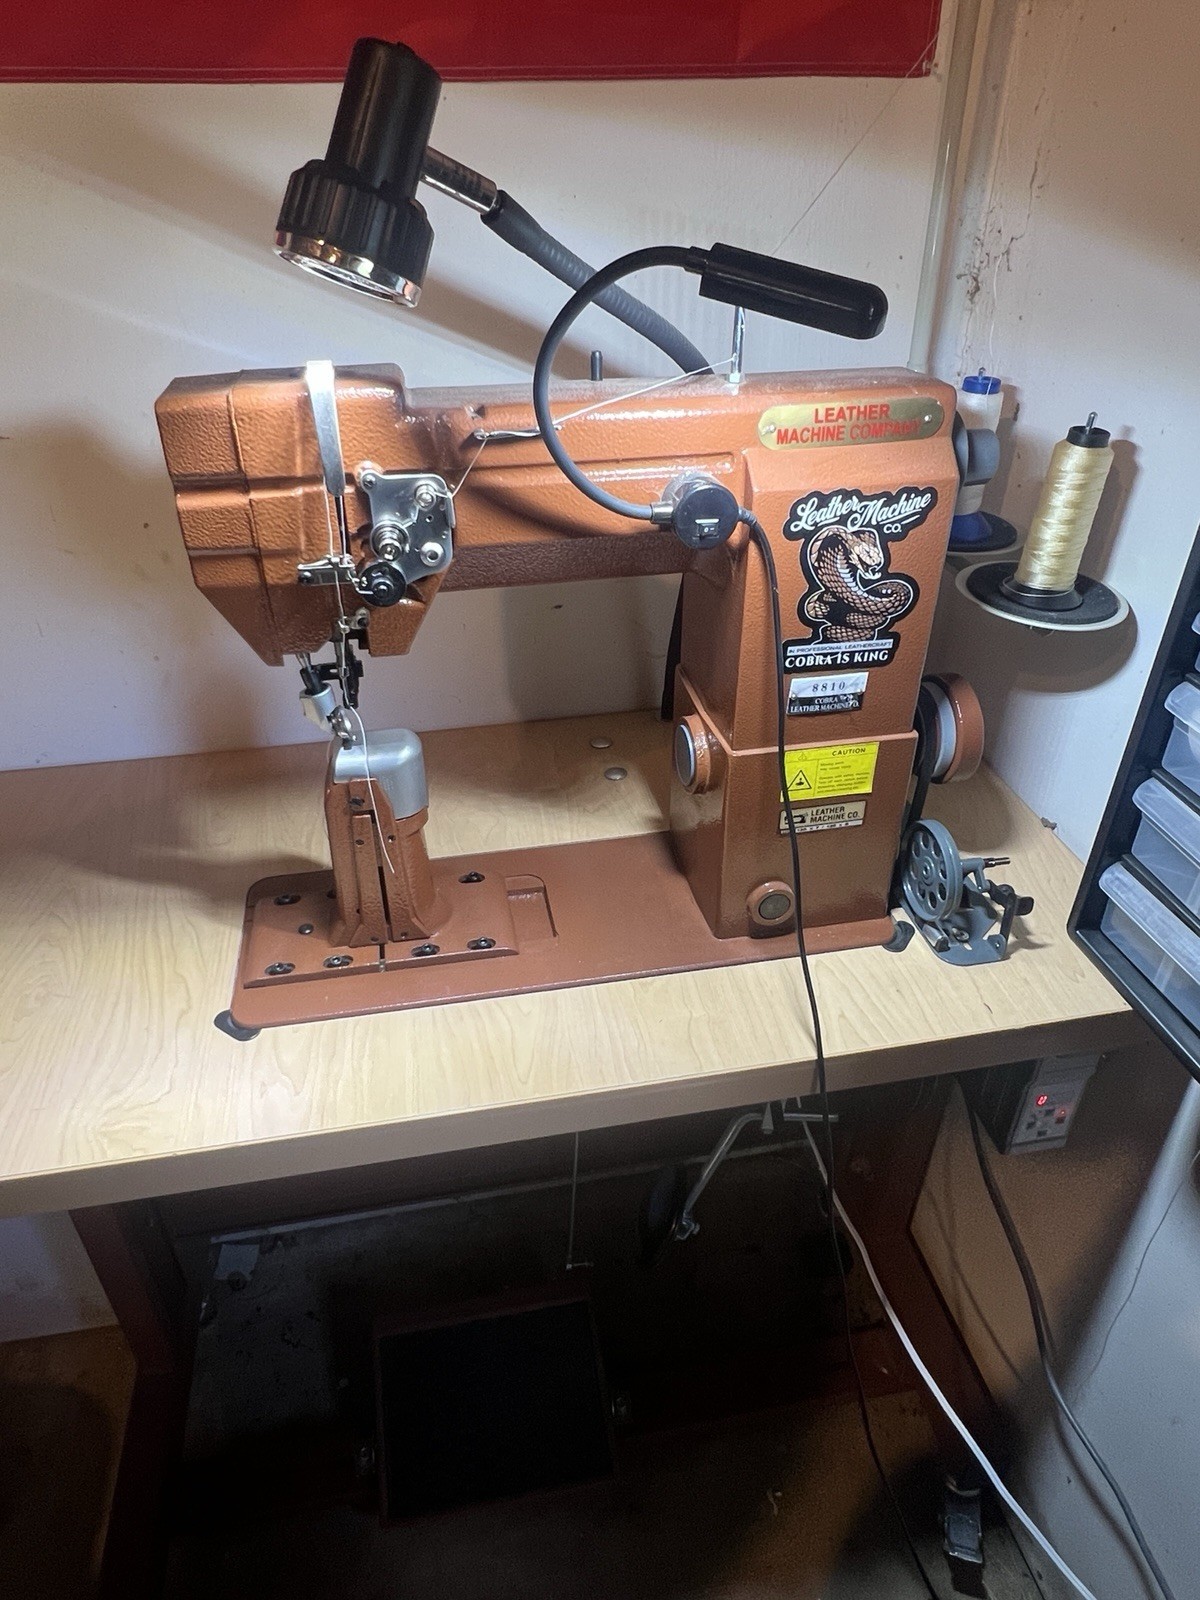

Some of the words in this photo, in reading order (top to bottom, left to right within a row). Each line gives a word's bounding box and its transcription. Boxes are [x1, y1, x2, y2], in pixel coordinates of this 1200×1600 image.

[814, 403, 890, 424] LEATHER
[776, 424, 846, 445] MACHINE
[790, 494, 858, 532] Leather
[847, 493, 932, 532] Machine
[883, 523, 902, 534] CO.
[796, 644, 842, 653] PROFESSIONAL
[844, 640, 892, 650] LEATHERCRAFT
[785, 654, 832, 668] COBRA
[836, 652, 850, 664] IS
[853, 650, 889, 663] KING
[812, 681, 846, 693] 8810
[790, 704, 820, 713] LEATHER
[832, 747, 866, 757] CAUTION
[810, 806, 845, 817] LEATHER
[809, 813, 845, 824] MACHINE
